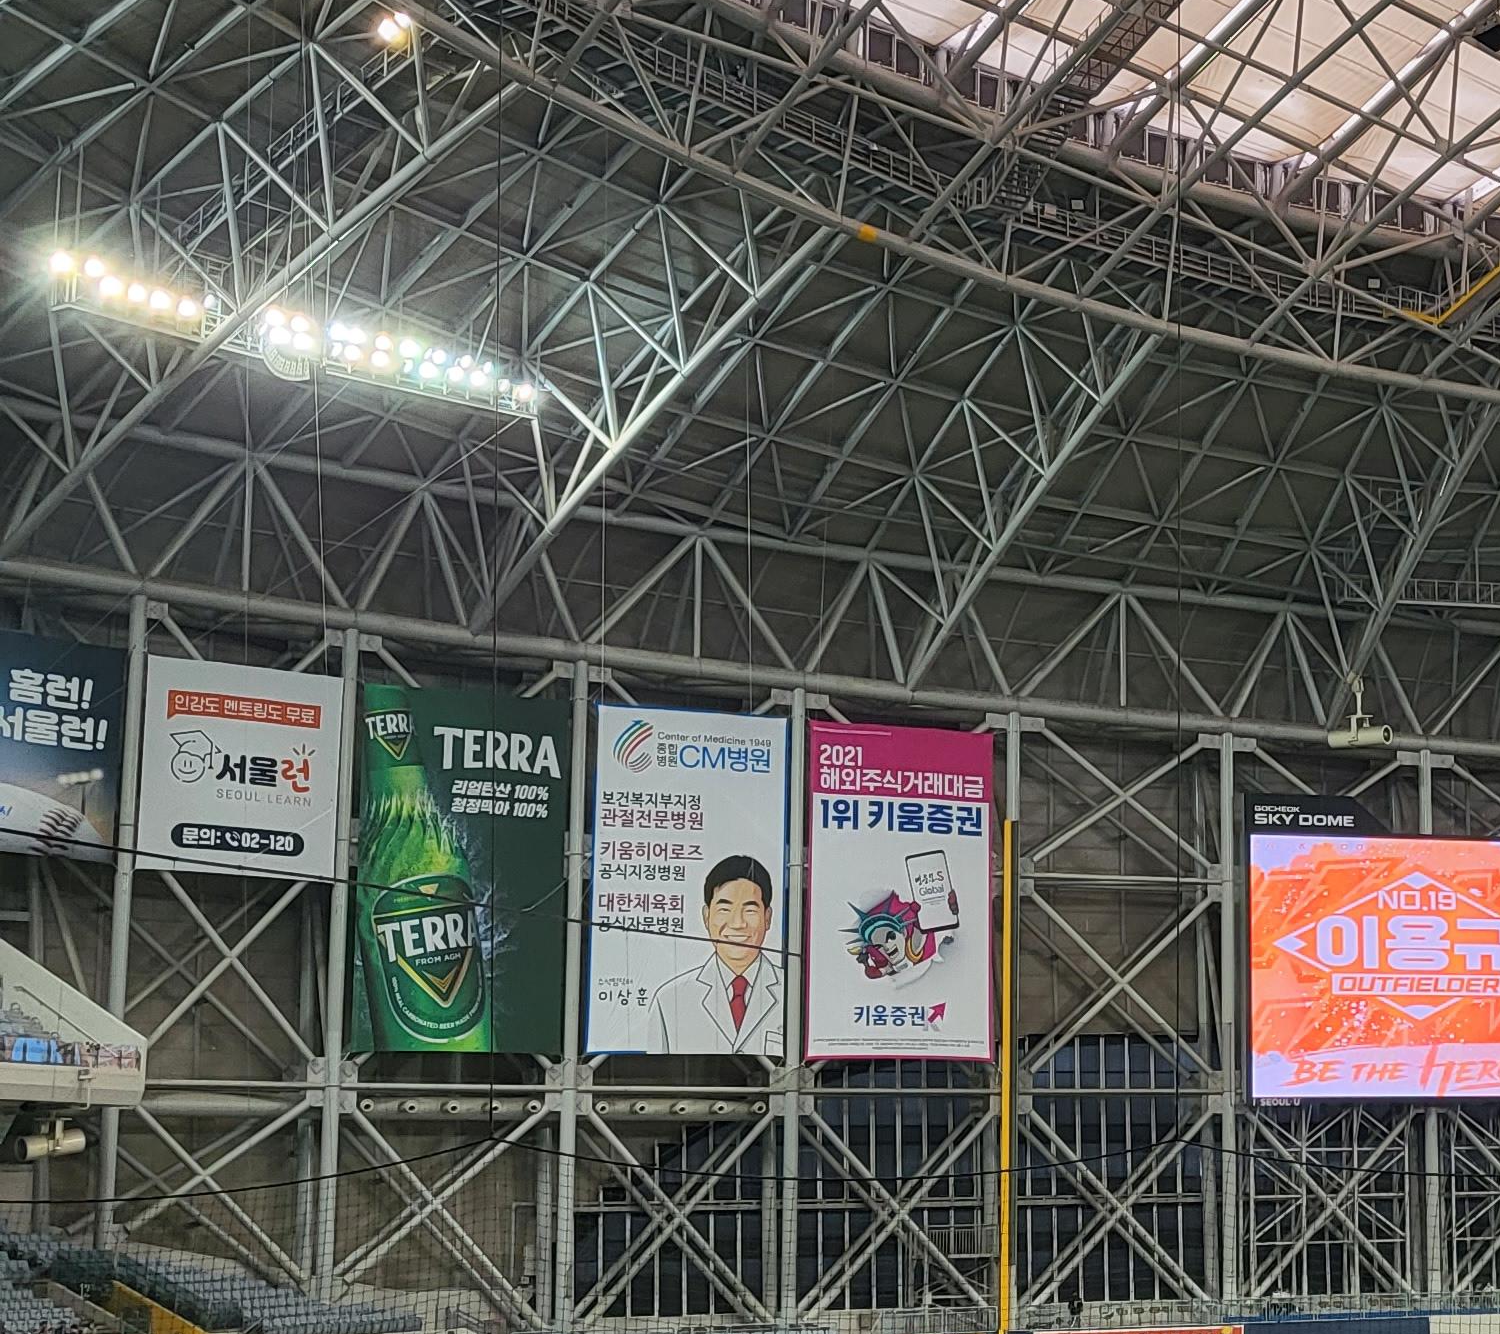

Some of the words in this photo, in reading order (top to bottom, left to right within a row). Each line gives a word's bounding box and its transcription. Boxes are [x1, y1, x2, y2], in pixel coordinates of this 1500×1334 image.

[9, 668, 94, 710] 홈런!
[174, 694, 220, 713] 인강도
[223, 698, 283, 721] 멘토링도
[286, 706, 316, 724] 무료
[0, 705, 108, 751] 서울런!
[657, 732, 690, 743] Center
[691, 735, 702, 744] of
[703, 735, 746, 747] Medicine
[749, 738, 772, 748] 1949
[433, 726, 562, 779] TERRA
[679, 744, 771, 774] CM병원
[819, 744, 863, 767] 2021
[215, 753, 311, 793] 서울런
[819, 766, 985, 798] 해외주식거래대금
[216, 788, 262, 802] SEOUL
[267, 794, 312, 807] LEARN
[513, 784, 550, 801] 100%
[601, 790, 702, 812] 보건복지부지정
[512, 800, 548, 818] 100%
[601, 807, 704, 831] 관절전문병원
[820, 798, 860, 831] 1위
[867, 800, 983, 837] 키움증권
[1254, 813, 1295, 825] SKY
[1298, 814, 1355, 827] DOME
[182, 826, 221, 846] 문의:
[241, 832, 294, 852] 02-120
[600, 841, 704, 860] 키움히어로즈
[599, 863, 686, 881] 공식지정병원
[599, 893, 684, 914] 대한체육회
[1377, 890, 1457, 911] NO.19
[377, 910, 480, 963] TERRA
[1339, 977, 1500, 993] OUTFIELDER
[854, 1004, 925, 1026] 키움증권
[1282, 1058, 1344, 1087] BE
[1350, 1063, 1409, 1083] THE
